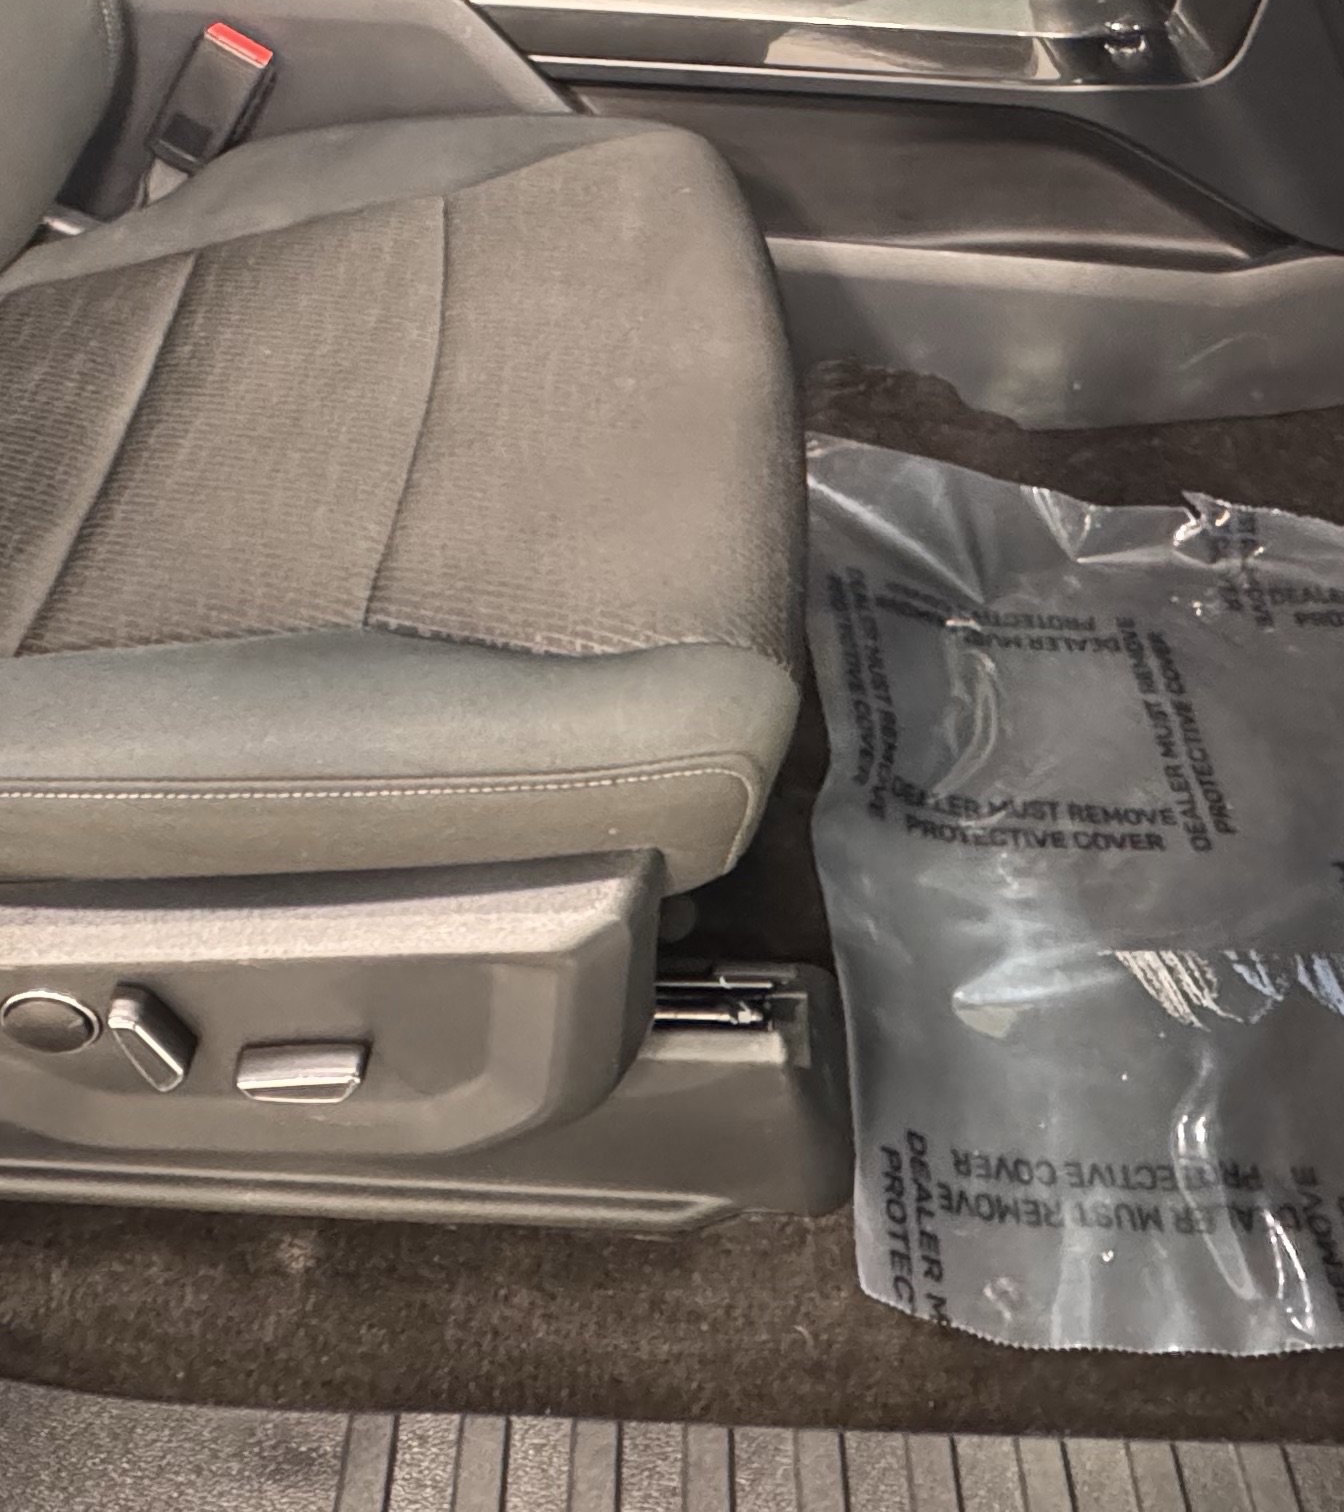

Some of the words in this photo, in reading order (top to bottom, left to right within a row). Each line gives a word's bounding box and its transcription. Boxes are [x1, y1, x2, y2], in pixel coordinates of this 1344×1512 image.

[1142, 698, 1179, 759] MUST
[1170, 698, 1239, 835] PROTECTIVE
[988, 799, 1060, 822] MUST
[1066, 802, 1178, 827] REMOVE
[1163, 763, 1214, 853] DEALER
[905, 813, 1068, 848] PROTECTIVE
[1072, 829, 1166, 852] COVER
[952, 1148, 1059, 1187] COVER
[905, 1127, 945, 1283] DEALER
[938, 1182, 1061, 1229] REMOVE
[1063, 1198, 1166, 1235] MUST
